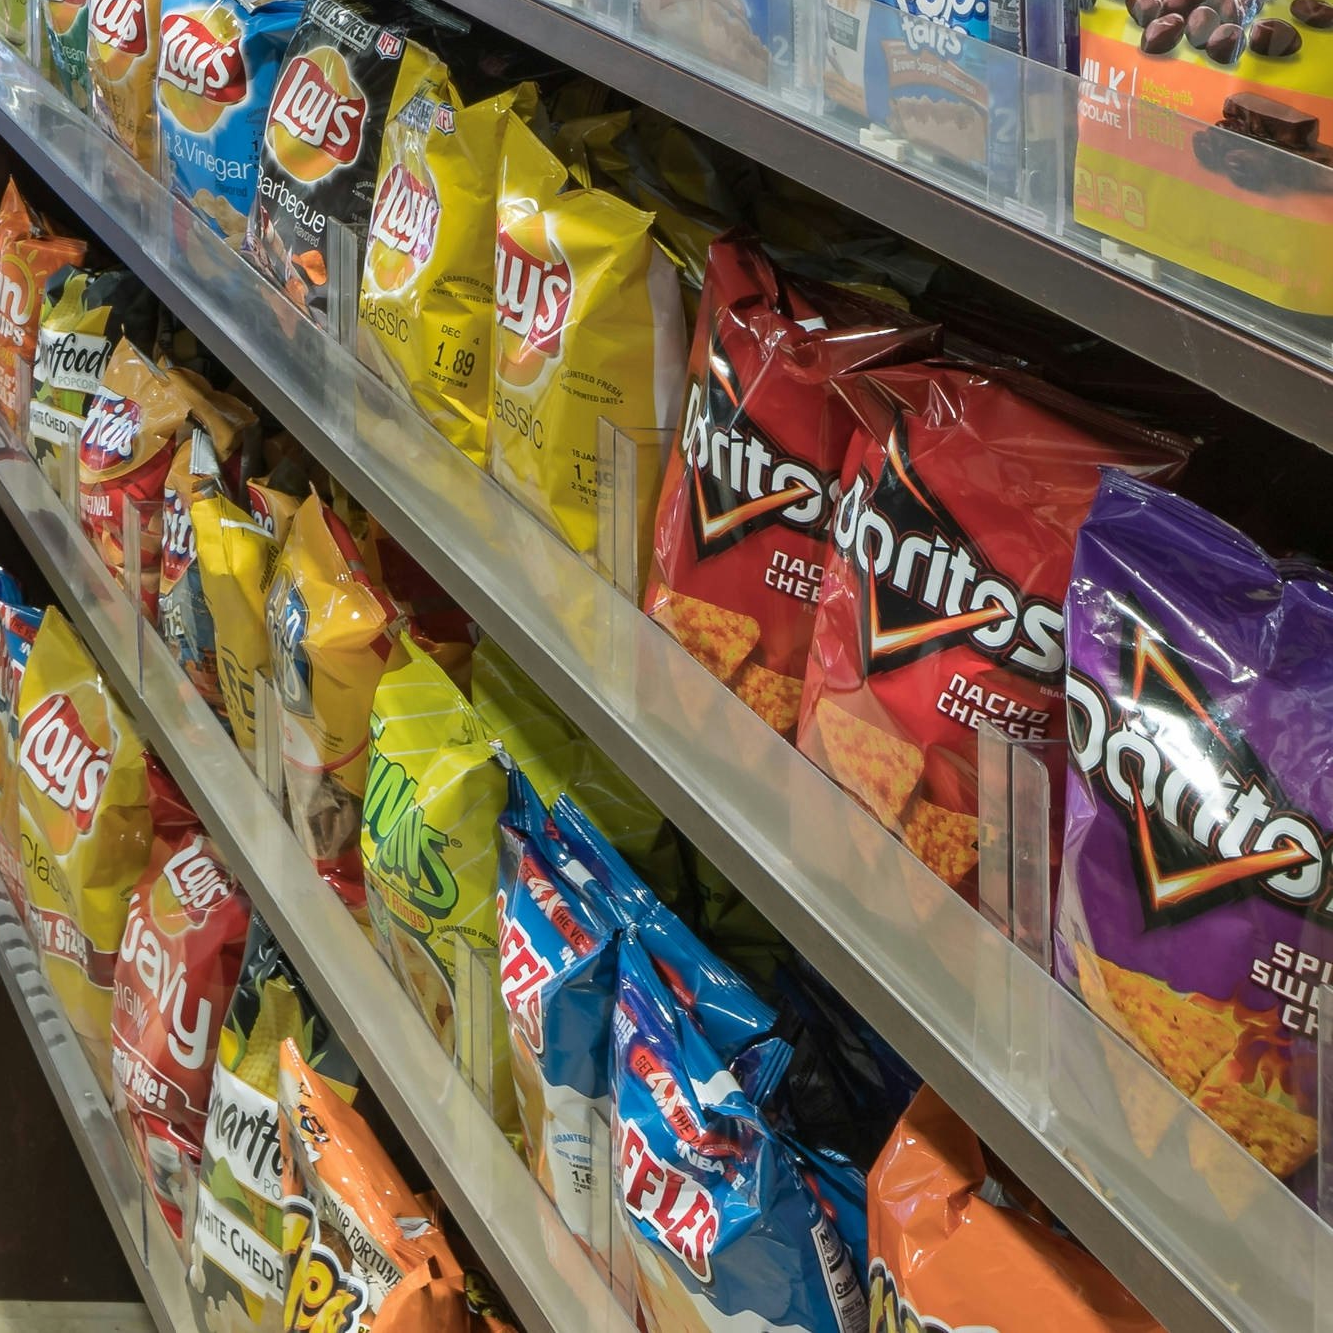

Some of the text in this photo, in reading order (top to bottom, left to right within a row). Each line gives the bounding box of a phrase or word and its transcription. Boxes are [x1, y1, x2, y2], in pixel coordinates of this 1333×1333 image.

[161, 13, 237, 94] Lay's
[376, 32, 400, 57] NFL
[273, 61, 361, 149] Lay's
[1142, 77, 1194, 107] Made with
[435, 107, 455, 132] NFL
[1136, 119, 1188, 153] FRUIT
[184, 141, 251, 182] Vinegar
[257, 165, 326, 233] Barbecue
[293, 222, 321, 248] Flavored
[434, 273, 480, 288] GUARANTEED
[440, 324, 480, 346] DEC 4
[433, 341, 476, 378] 1.89
[574, 389, 619, 406] PRINTED DATE
[595, 377, 624, 398] FRESH
[834, 473, 1065, 674] Doritos
[950, 671, 1051, 724] NACHO
[935, 693, 1047, 744] CHEESE
[20, 696, 113, 817] Lay's
[163, 834, 230, 910] Lay's
[391, 896, 427, 932] Rings
[131, 1066, 169, 1111] Size!
[634, 1054, 696, 1139] GET THE
[678, 1140, 725, 1177] NBA
[348, 1225, 401, 1287] FORTUNE
